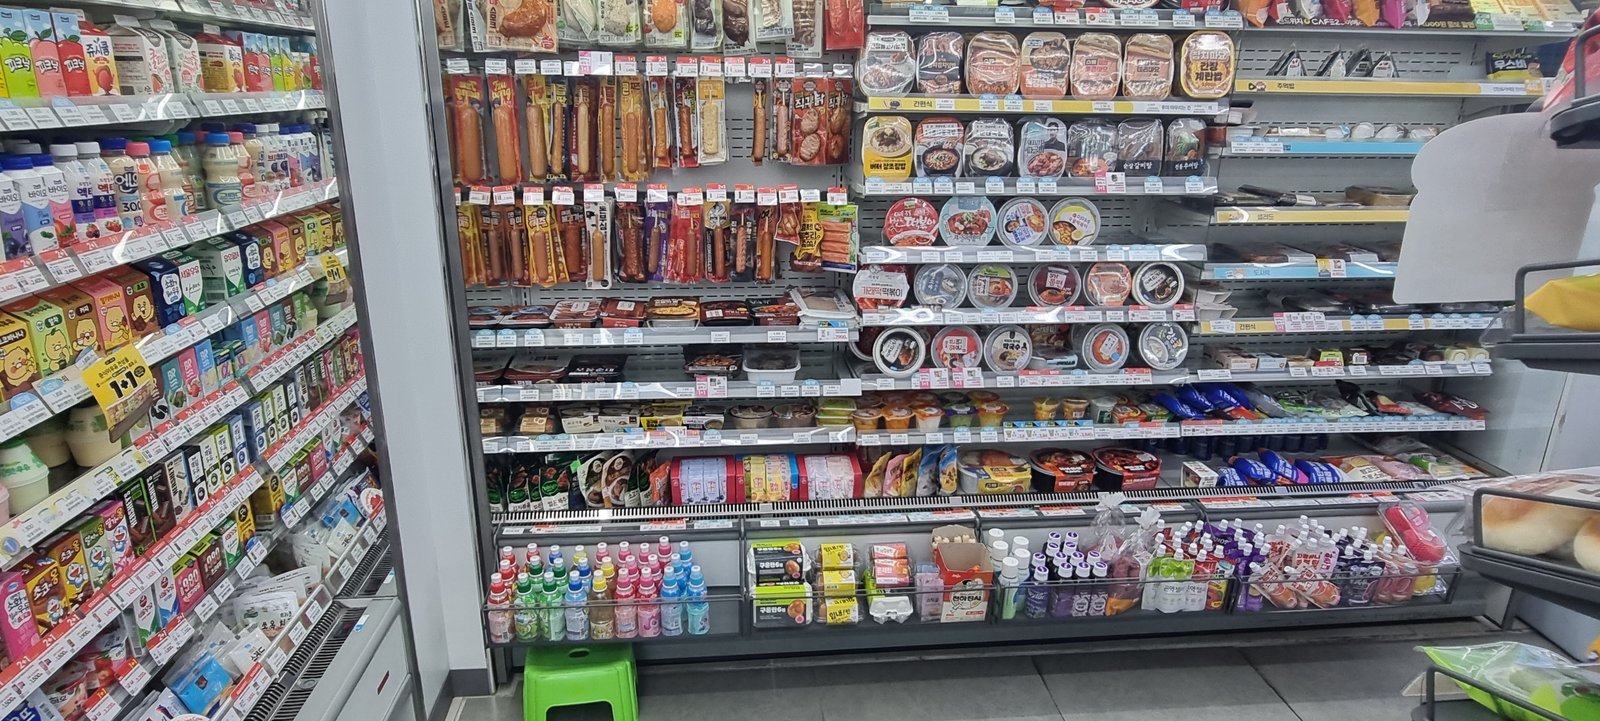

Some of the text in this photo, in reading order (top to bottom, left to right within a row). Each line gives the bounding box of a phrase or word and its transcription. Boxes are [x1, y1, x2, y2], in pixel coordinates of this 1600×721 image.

[86, 40, 110, 58] 쥬시쿨
[4, 57, 31, 73] 피크닉
[36, 59, 59, 74] 피크닉
[64, 58, 85, 73] 피크닉
[1199, 61, 1219, 71] 간장
[1194, 71, 1222, 82] 계란밥
[913, 100, 932, 108] 간편식
[28, 189, 48, 200] 바이오
[48, 184, 69, 194] 바이오
[86, 241, 98, 252] 2+1
[55, 249, 69, 258] 2+1
[20, 257, 35, 268] 2+1
[1253, 269, 1271, 277] 도시락
[1239, 322, 1256, 330] 간편식
[109, 370, 138, 399] 1+1
[202, 399, 210, 408] 2+1
[185, 409, 194, 419] 2+1
[165, 421, 175, 431] 2+1
[146, 432, 155, 442] 2+1
[676, 428, 687, 436] 1+1
[221, 485, 231, 495] 2+1
[207, 498, 217, 509] 2+1
[67, 614, 80, 626] 2+1
[42, 633, 57, 648] 2+1
[157, 629, 168, 641] 2+1
[16, 655, 31, 669] 2+1
